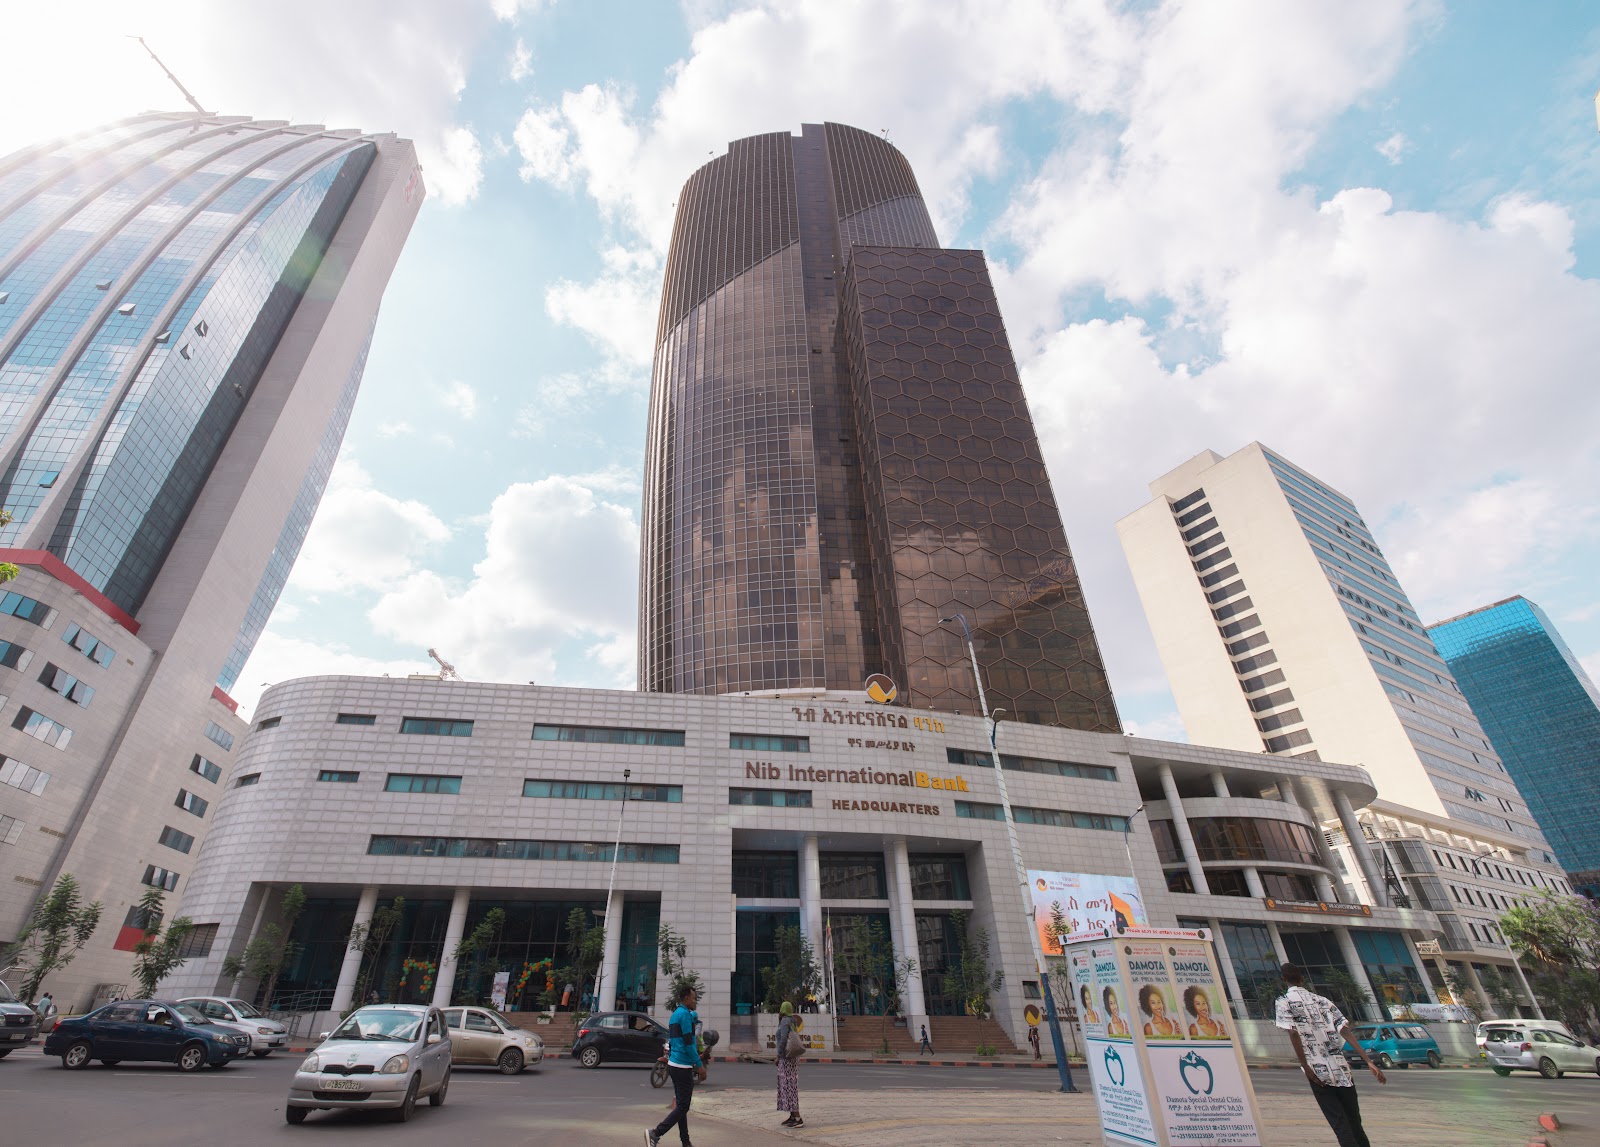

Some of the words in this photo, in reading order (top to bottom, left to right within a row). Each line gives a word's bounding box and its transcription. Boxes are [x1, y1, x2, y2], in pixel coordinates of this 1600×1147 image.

[792, 708, 815, 722] ንብ
[823, 708, 908, 728] ኢንተርናሽናል
[914, 716, 944, 733] ባንክ
[746, 761, 780, 780] Nib
[832, 799, 939, 816] HEADQUARTERS
[1095, 962, 1116, 972] DAMOTA
[1129, 961, 1165, 971] DAMOTA
[1173, 961, 1209, 972] DAMOTA
[1188, 1096, 1206, 1104] Special
